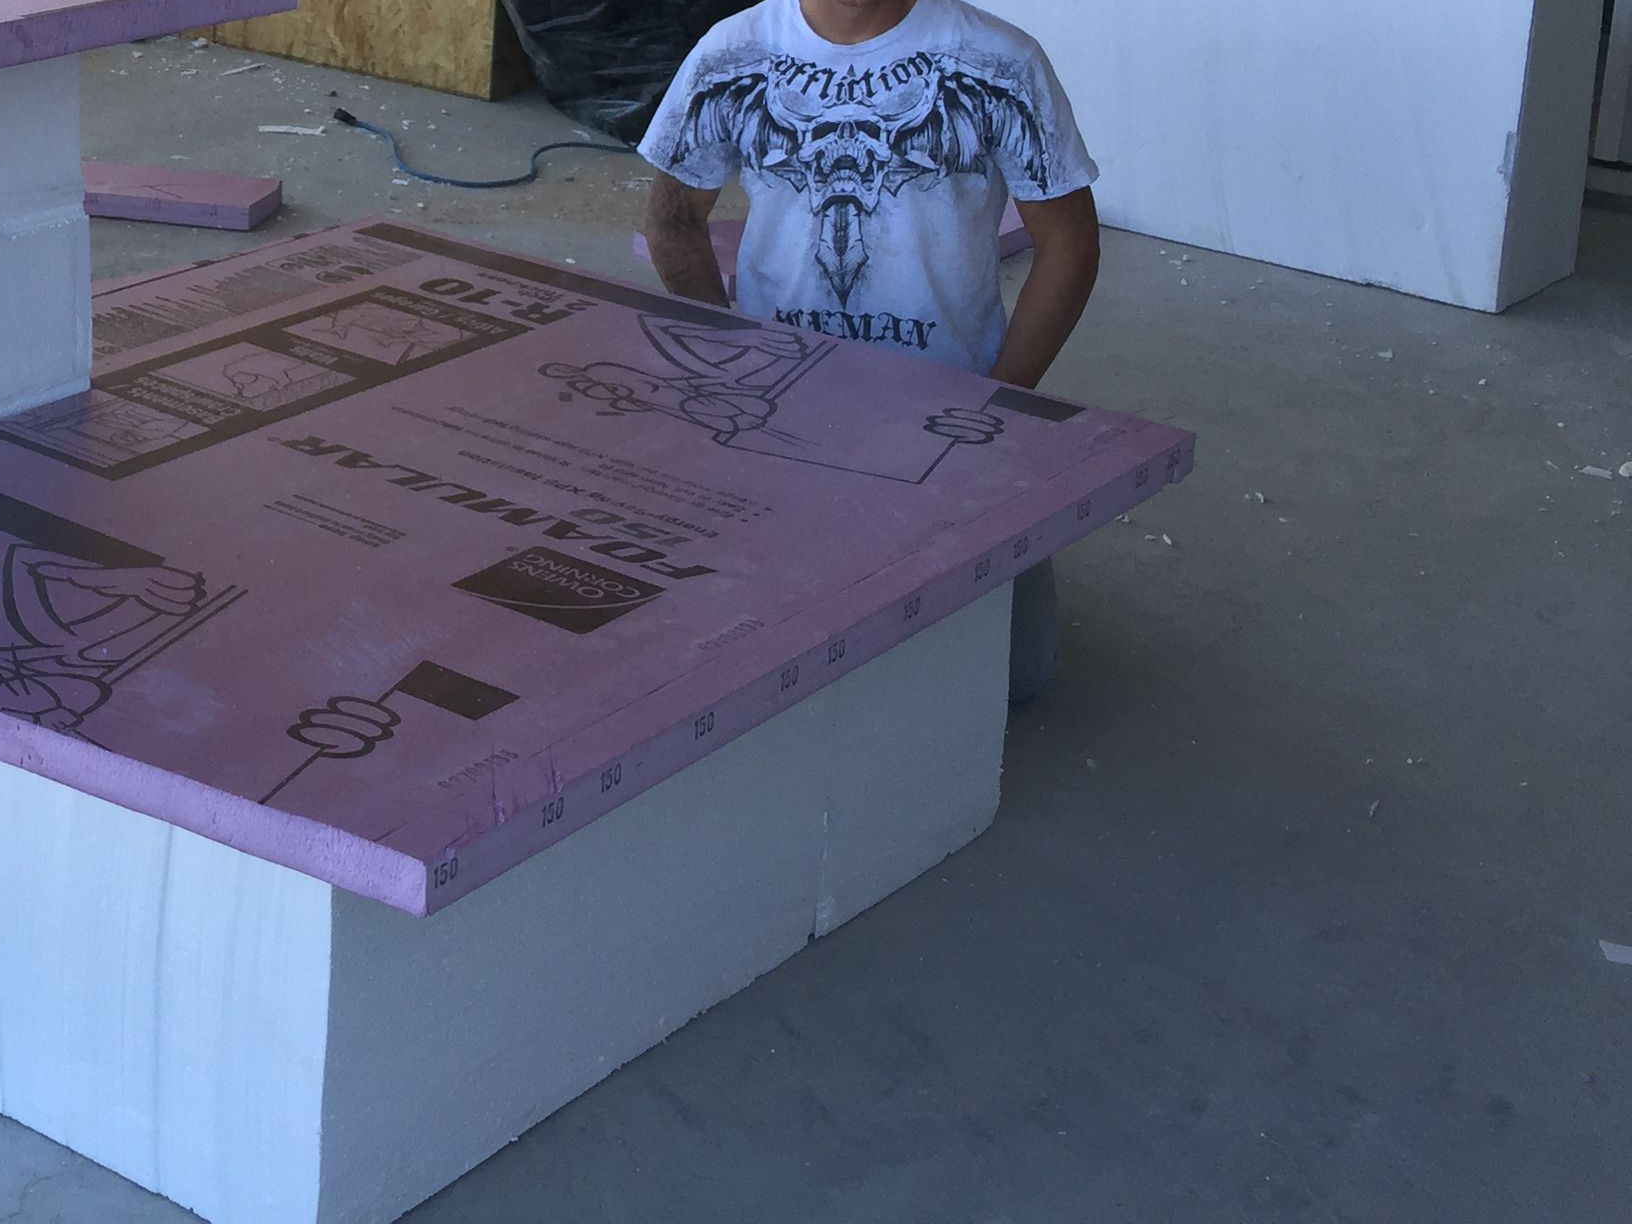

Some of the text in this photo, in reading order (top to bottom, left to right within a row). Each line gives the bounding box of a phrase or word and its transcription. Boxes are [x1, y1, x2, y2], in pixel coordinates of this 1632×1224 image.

[418, 278, 574, 325] R-10
[127, 387, 224, 425] Basements
[281, 436, 719, 580] FOAMULAR
[569, 508, 694, 547] 150
[508, 560, 604, 599] OWENS
[526, 553, 641, 599] CORNING
[827, 639, 845, 664] 150
[780, 666, 799, 691] 150
[694, 712, 714, 740] 150
[600, 762, 622, 793] 150
[541, 797, 564, 827] 150
[434, 857, 458, 889] 150
